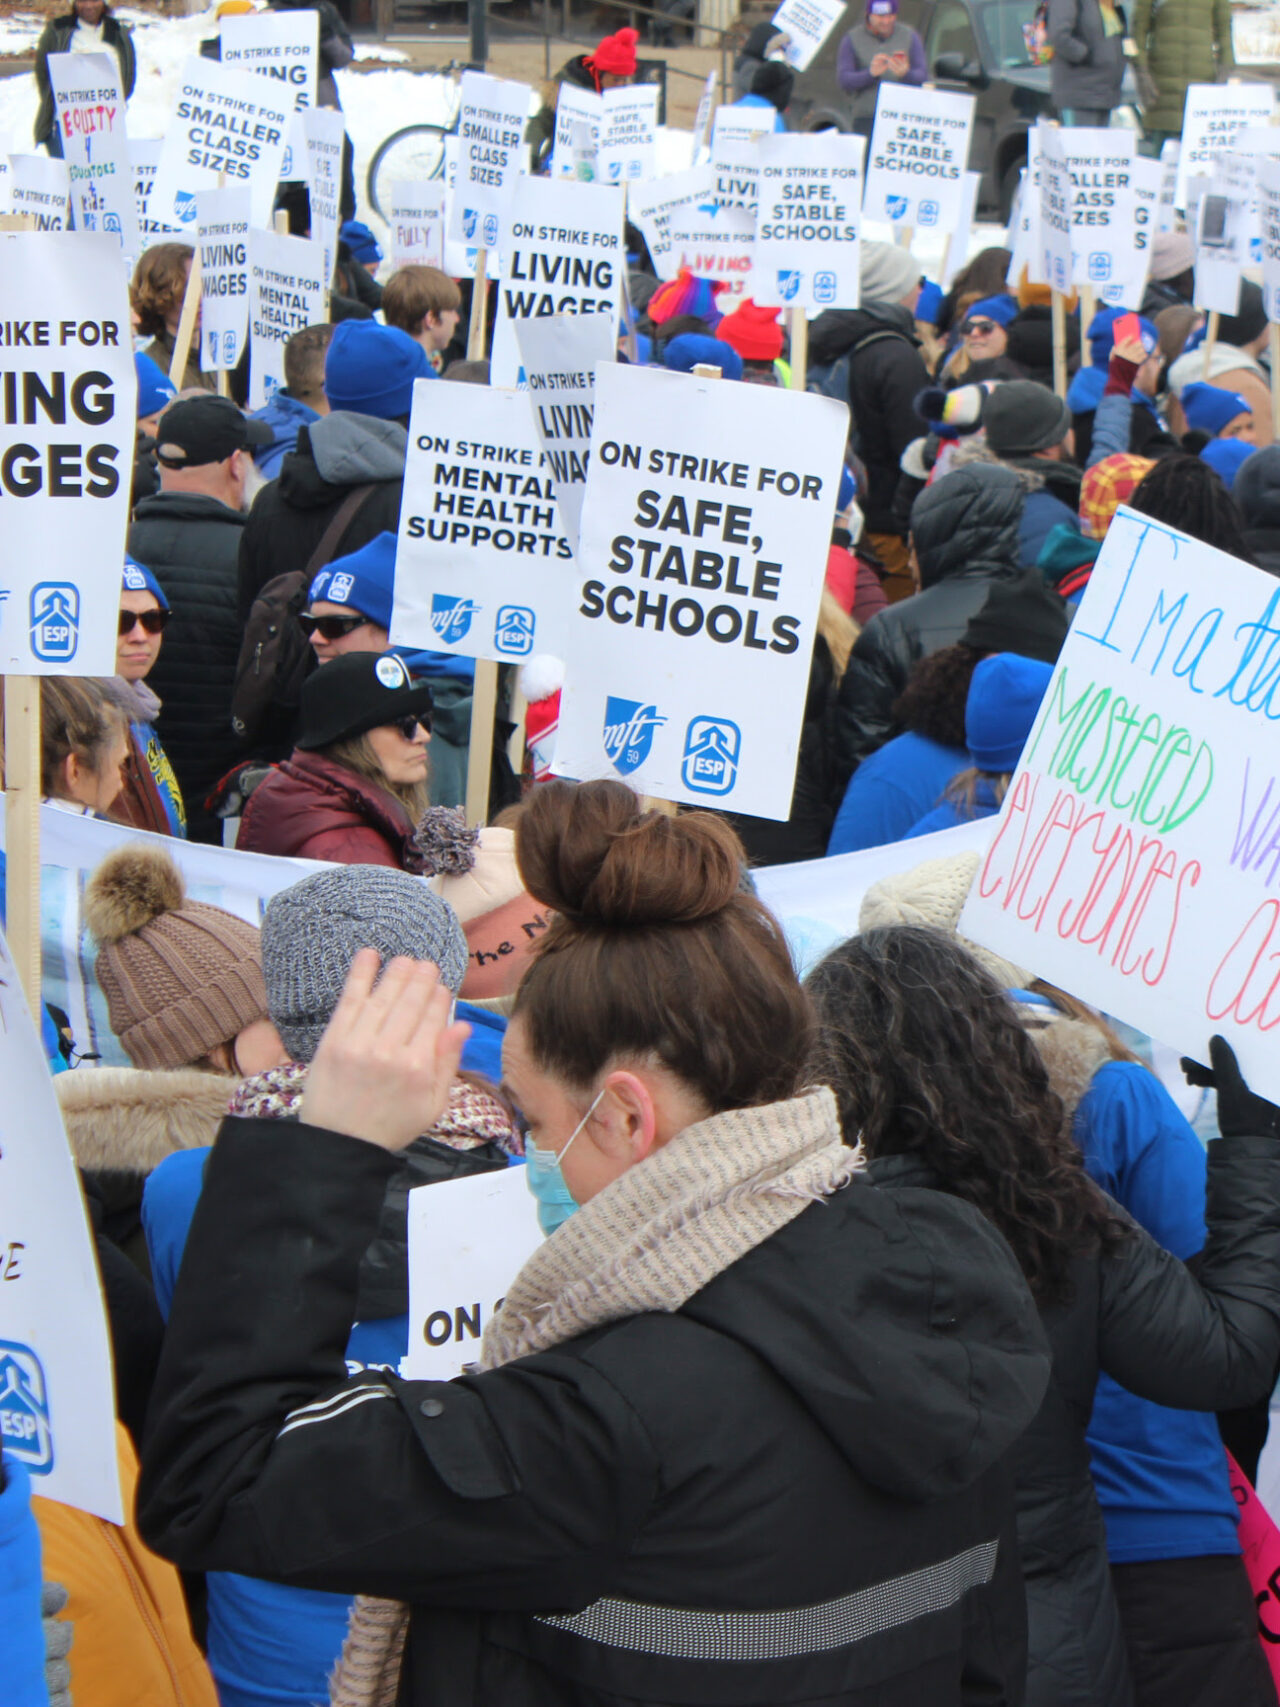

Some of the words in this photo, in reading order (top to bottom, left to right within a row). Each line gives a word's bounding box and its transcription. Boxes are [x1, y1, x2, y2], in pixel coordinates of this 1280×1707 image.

[225, 50, 240, 60] ON
[244, 47, 280, 59] STRIKE
[284, 46, 310, 56] FOR
[70, 90, 96, 102] STRIKE
[98, 89, 117, 100] FOR
[183, 85, 203, 98] ON
[207, 92, 255, 114] STRIKE
[258, 108, 284, 123] FOR
[63, 106, 116, 137] EQUITY
[177, 102, 280, 145] SMALLER
[901, 113, 940, 126] STRIKE
[943, 120, 965, 129] FOR
[188, 128, 261, 160] CLASS
[463, 123, 519, 148] SMALLER
[187, 149, 250, 179] SIZES
[470, 145, 508, 167] CLASS
[886, 142, 953, 161] STABLE
[1104, 158, 1130, 168] FOR
[470, 166, 503, 187] SIZES
[764, 168, 782, 177] ON
[786, 168, 827, 178] STRIKE
[832, 169, 856, 178] FOR
[873, 156, 960, 179] SCHOOLS
[782, 184, 837, 202] SAFE,
[773, 205, 845, 221] STABLE
[232, 223, 248, 233] FOR
[513, 224, 534, 238] ON
[539, 226, 589, 245] STRIKE
[593, 234, 618, 248] FOR
[692, 233, 730, 242] STRIKE
[761, 225, 856, 241] SCHOOLS
[202, 244, 246, 268] LIVING
[253, 266, 263, 277] ON
[265, 270, 295, 287] STRIKE
[298, 278, 320, 292] FOR
[512, 251, 612, 289] LIVING
[202, 273, 247, 298] WAGES
[260, 285, 309, 311] MENTAL
[261, 305, 308, 329] HEALTH
[0, 321, 49, 346] IKE
[60, 321, 119, 346] FOR
[254, 321, 292, 344] SUPPO
[530, 374, 545, 389] ON
[547, 373, 585, 389] STRIKE
[0, 371, 114, 425] ING
[417, 436, 449, 453] ON
[456, 441, 532, 466] STRIKE
[0, 443, 120, 498] GES
[433, 463, 557, 500] MENTAL
[600, 441, 641, 469] ON
[648, 449, 749, 489] STRIKE
[757, 467, 823, 501] FOR
[433, 492, 554, 528] HEALTH
[634, 489, 763, 555] SAFE,
[407, 517, 573, 560] SUPPORTS
[608, 535, 782, 601] STABLE
[579, 579, 801, 655] SCHOOLS
[43, 627, 68, 641] ESP
[504, 631, 524, 643] ESP
[604, 703, 669, 764] mft
[695, 758, 723, 776] ESP
[627, 750, 639, 764] 59
[469, 941, 514, 966] he
[423, 1303, 481, 1346] ON
[0, 1412, 36, 1441] ESP
